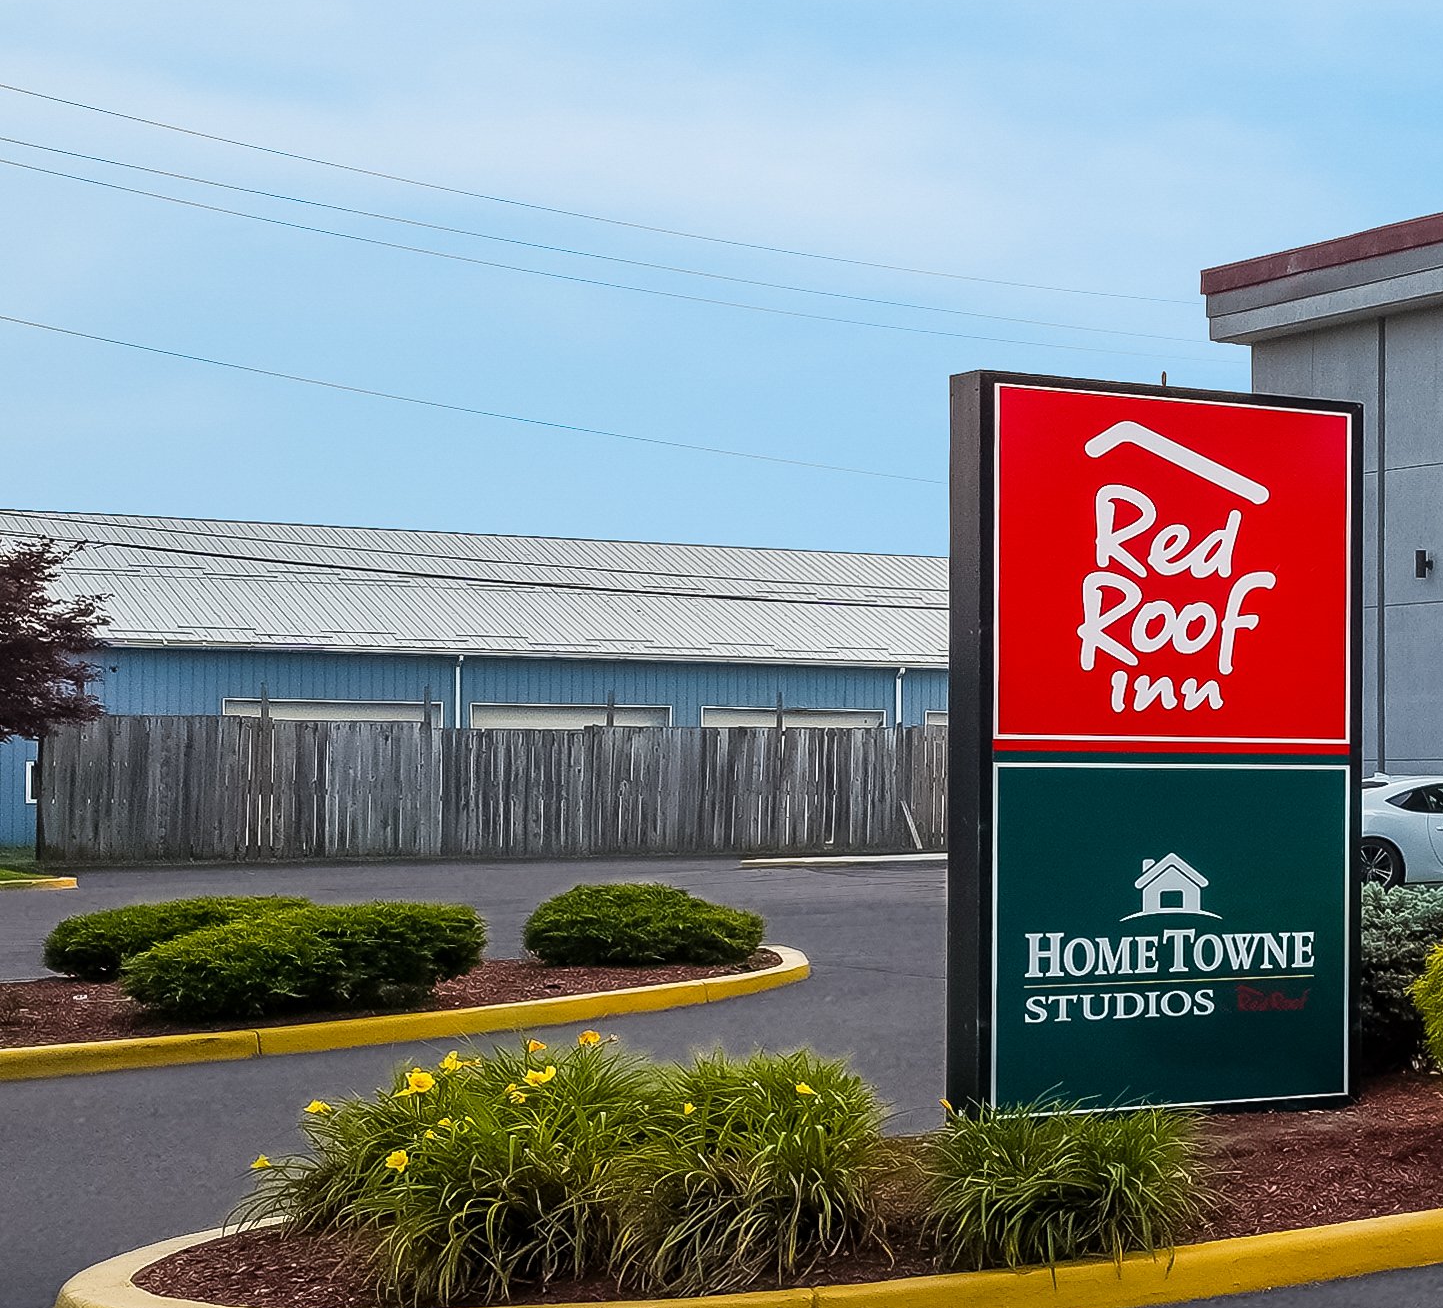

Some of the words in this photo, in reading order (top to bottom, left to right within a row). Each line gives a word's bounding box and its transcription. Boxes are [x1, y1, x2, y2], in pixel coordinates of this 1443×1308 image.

[1095, 484, 1242, 578] Red
[1077, 571, 1277, 675] Roof
[1025, 989, 1215, 1023] STUDIOS
